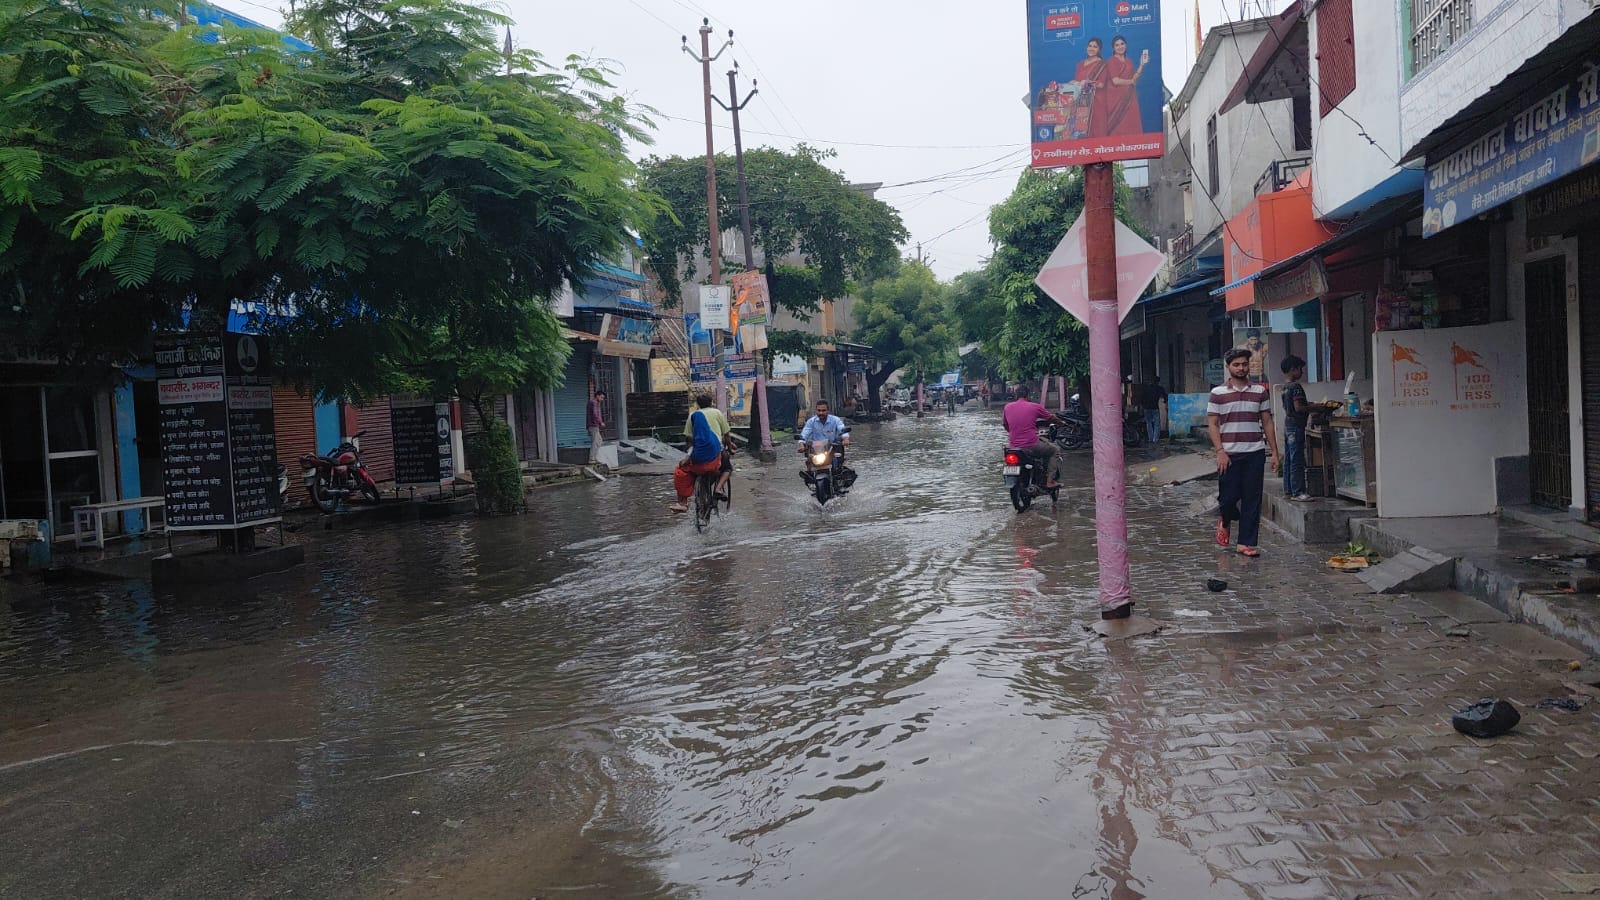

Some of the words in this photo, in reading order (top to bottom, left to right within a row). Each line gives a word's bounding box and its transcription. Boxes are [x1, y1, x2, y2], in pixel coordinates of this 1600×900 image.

[1428, 122, 1508, 190] जायसवाल
[1403, 388, 1429, 397] RSS
[1465, 390, 1492, 400] RSS
